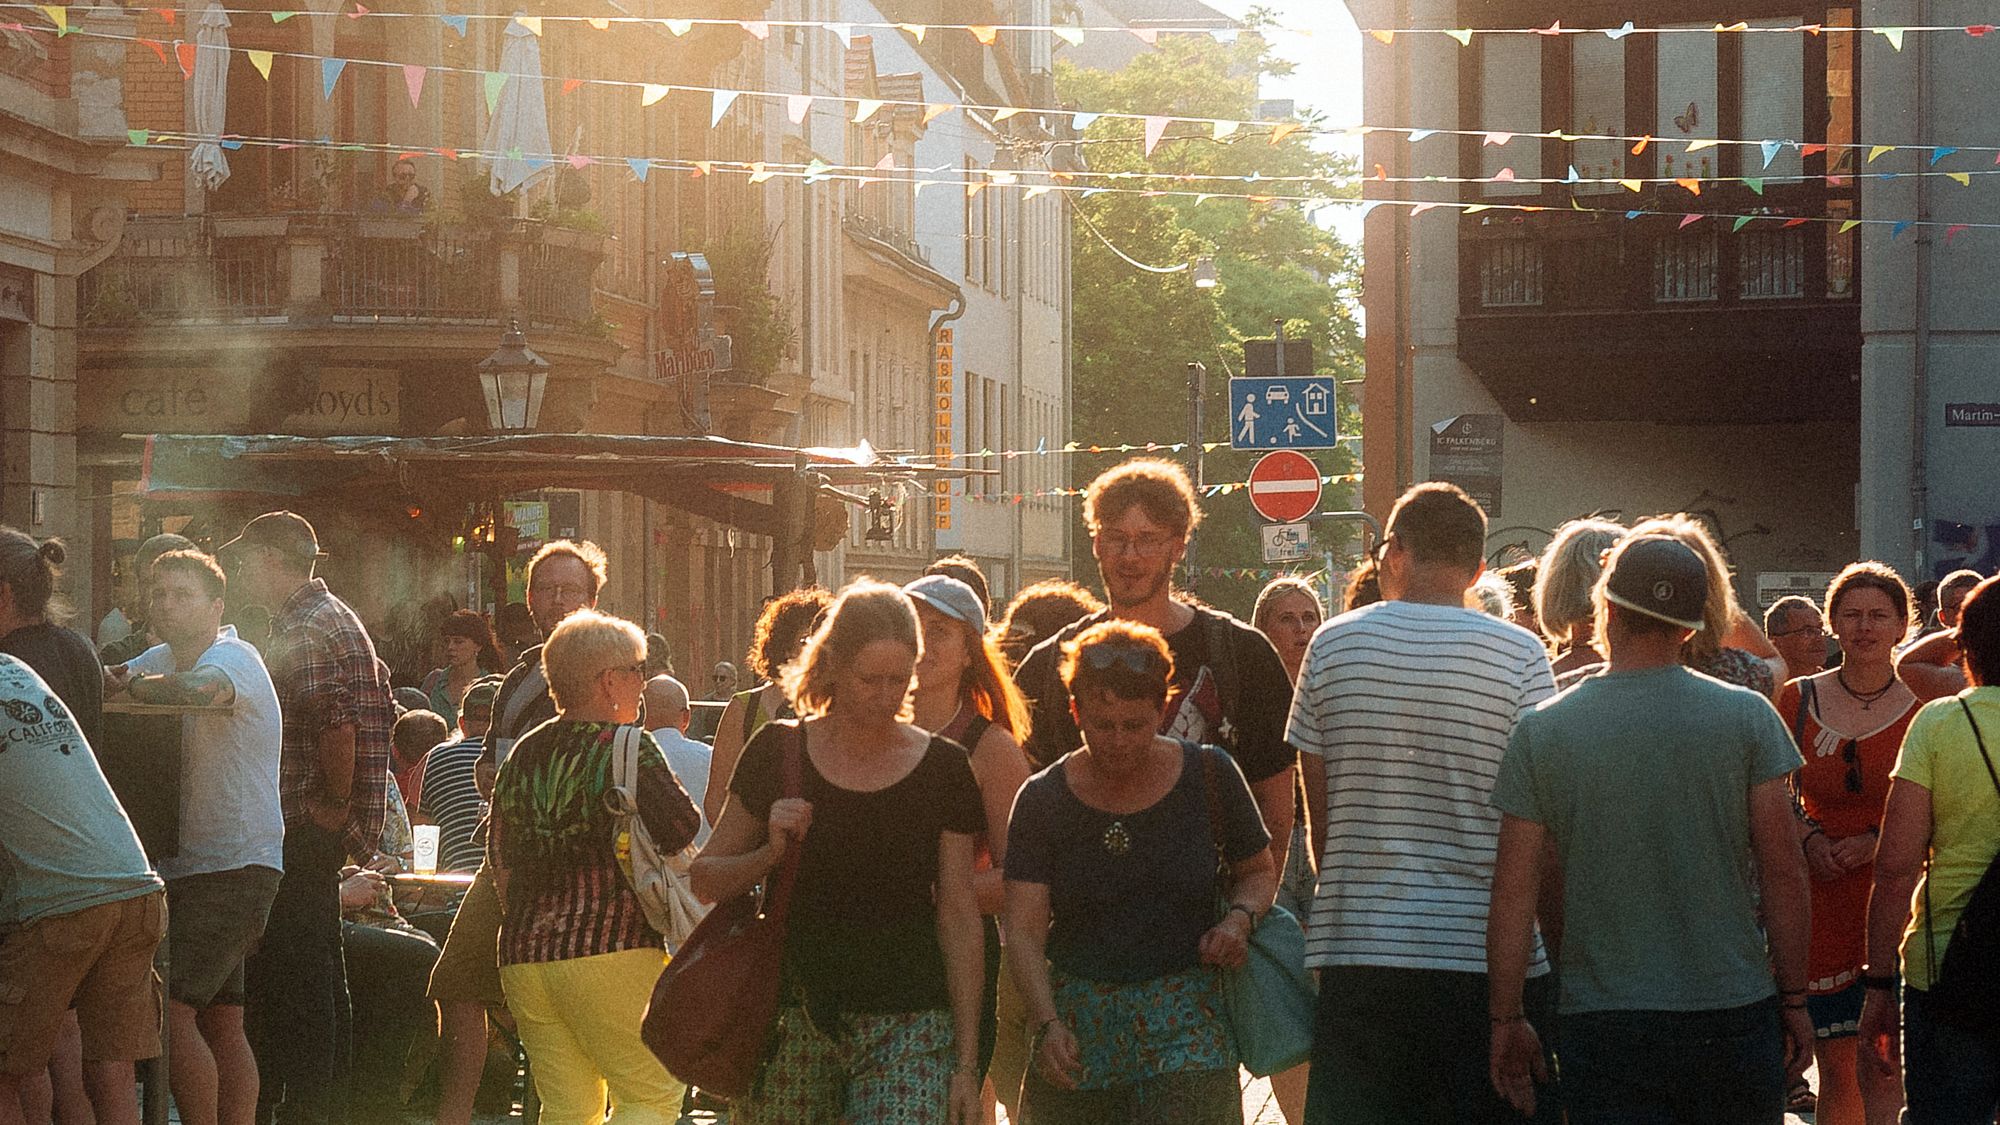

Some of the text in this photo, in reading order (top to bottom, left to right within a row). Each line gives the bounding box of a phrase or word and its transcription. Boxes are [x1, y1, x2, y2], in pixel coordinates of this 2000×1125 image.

[655, 346, 715, 379] Marlboro
[119, 375, 391, 424] café oyd's
[938, 328, 951, 529] RASKOLNIOFF
[1279, 546, 1296, 556] frei
